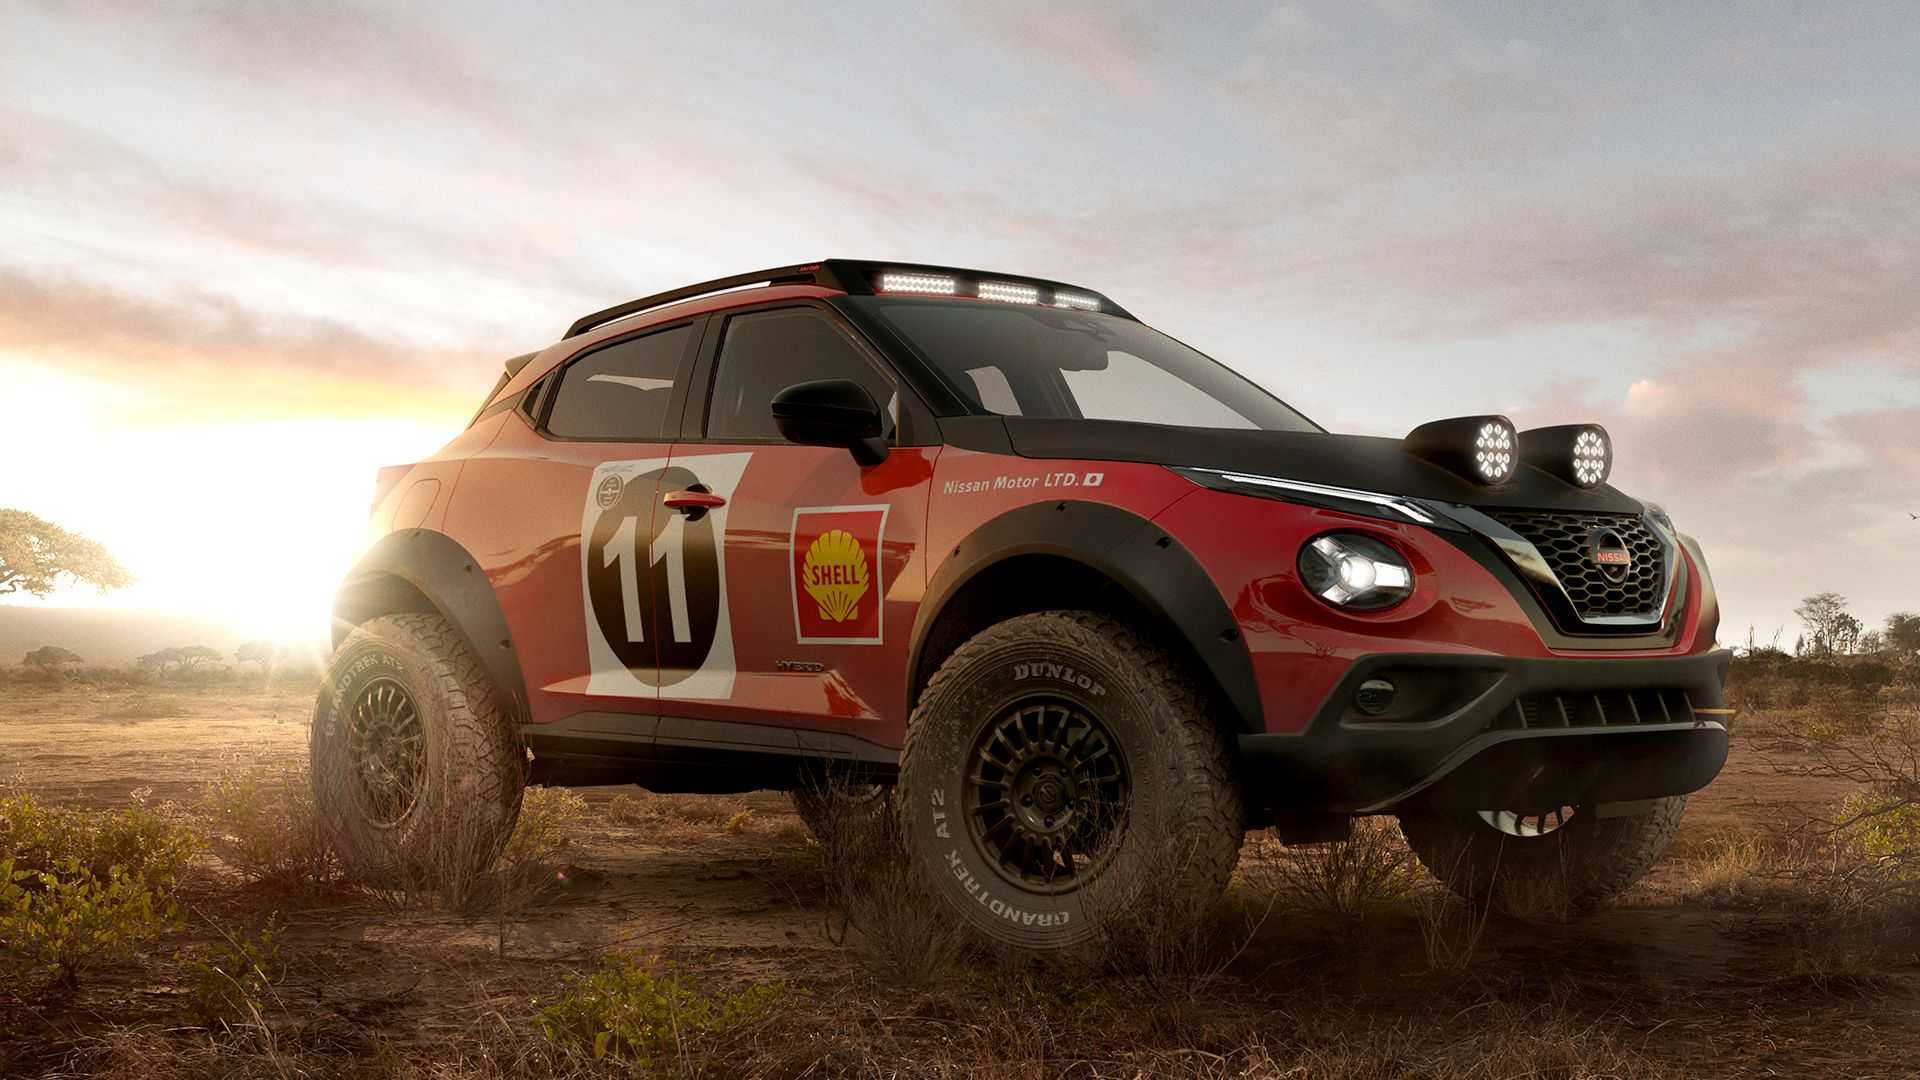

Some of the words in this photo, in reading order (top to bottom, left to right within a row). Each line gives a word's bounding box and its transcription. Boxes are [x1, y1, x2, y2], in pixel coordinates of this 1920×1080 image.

[943, 480, 990, 495] Nissan
[993, 475, 1040, 490] Motor
[1044, 472, 1079, 487] LTD.
[603, 513, 692, 643] 11
[812, 564, 860, 586] SHELL
[1014, 662, 1106, 696] DUNLOP
[930, 788, 951, 839] AT2
[944, 849, 1070, 927] GRANDTREK
